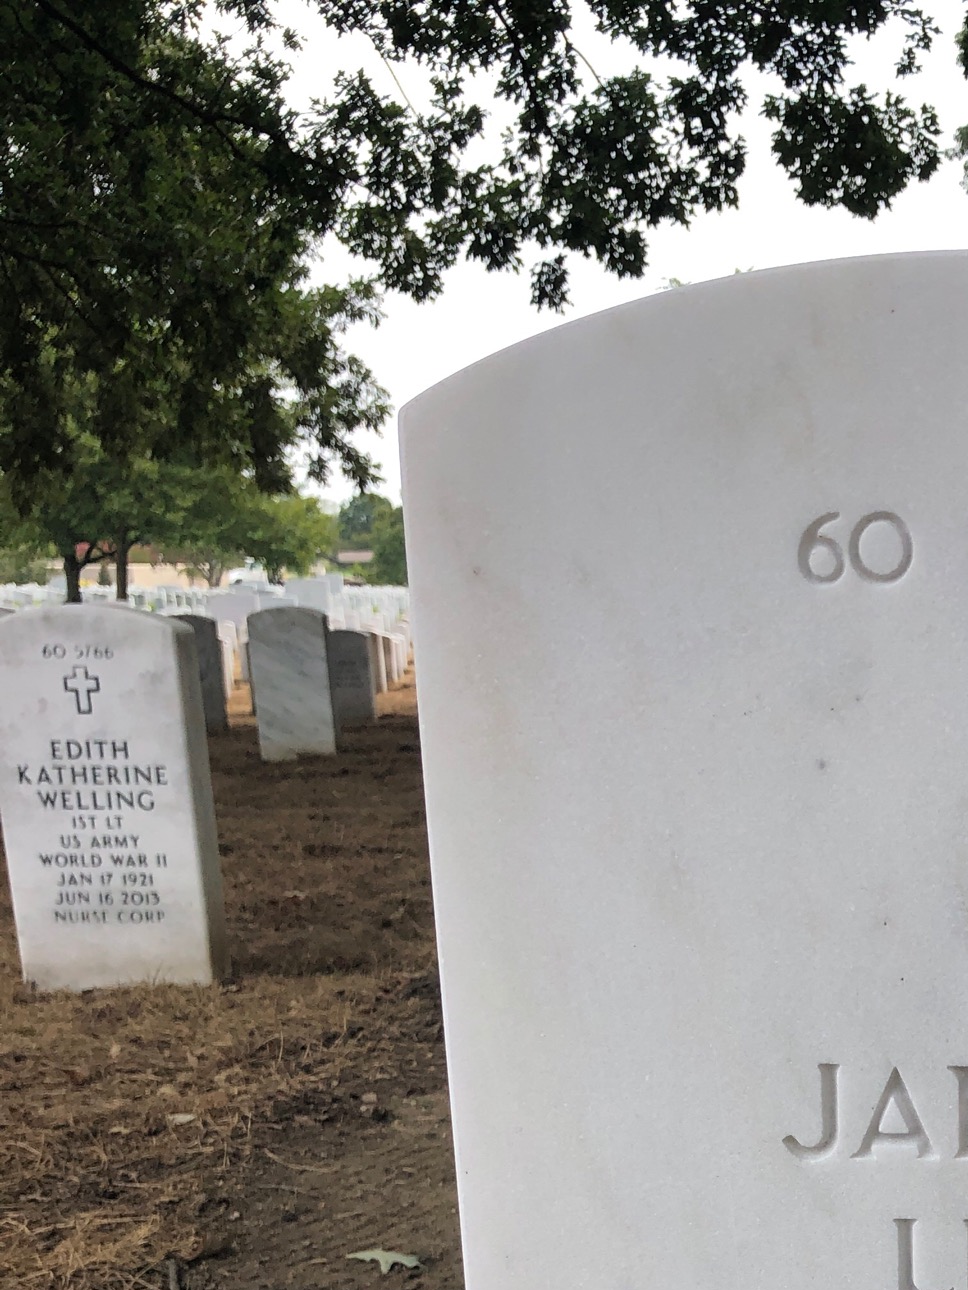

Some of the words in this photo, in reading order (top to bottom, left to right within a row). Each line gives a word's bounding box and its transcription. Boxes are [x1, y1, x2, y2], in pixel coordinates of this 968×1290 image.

[798, 510, 914, 585] 60
[42, 644, 66, 659] 60
[51, 739, 129, 760] EDITH
[18, 764, 168, 785] KATHERINE
[37, 790, 154, 811] WELLING
[106, 815, 123, 829] LT
[60, 835, 81, 848] US
[91, 835, 139, 848] ARMY
[39, 854, 102, 867] WORLD
[110, 854, 148, 867] WAR
[57, 872, 92, 886] JAN
[100, 873, 113, 885] 17
[123, 872, 153, 886] 1921
[55, 892, 90, 905] JUN
[99, 892, 113, 905] 16
[121, 892, 160, 905] 2013
